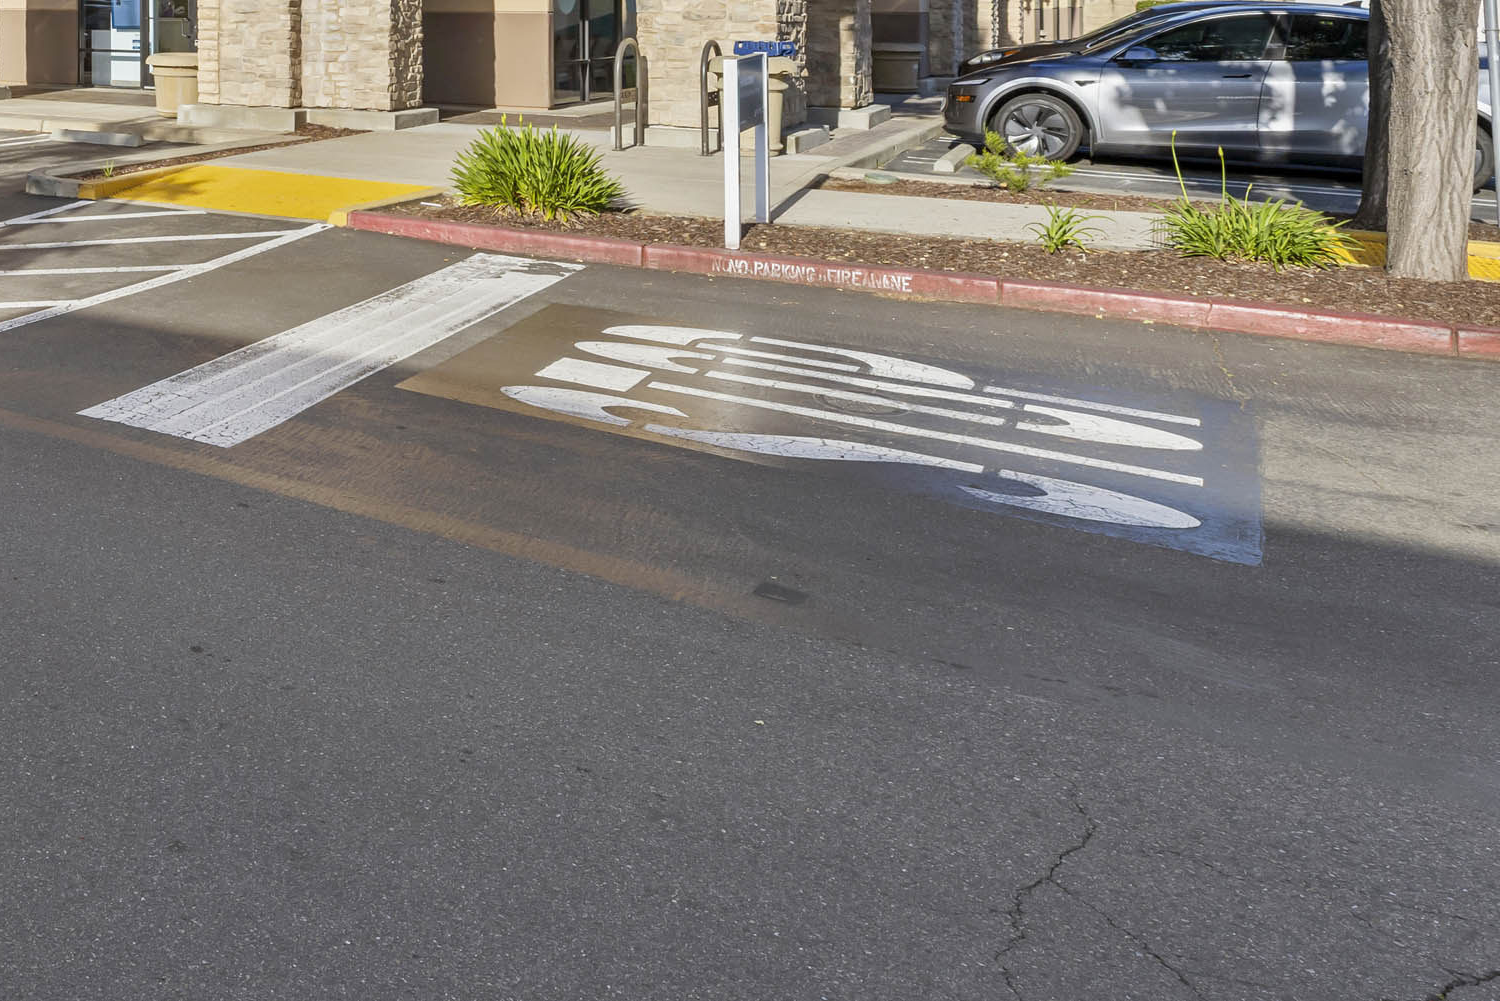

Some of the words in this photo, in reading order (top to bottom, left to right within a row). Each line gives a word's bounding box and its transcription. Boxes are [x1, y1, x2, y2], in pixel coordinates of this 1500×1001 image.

[728, 258, 749, 274] NO
[753, 261, 816, 283] PARKING
[827, 268, 863, 287] FIRE
[500, 324, 1204, 529] STOP
